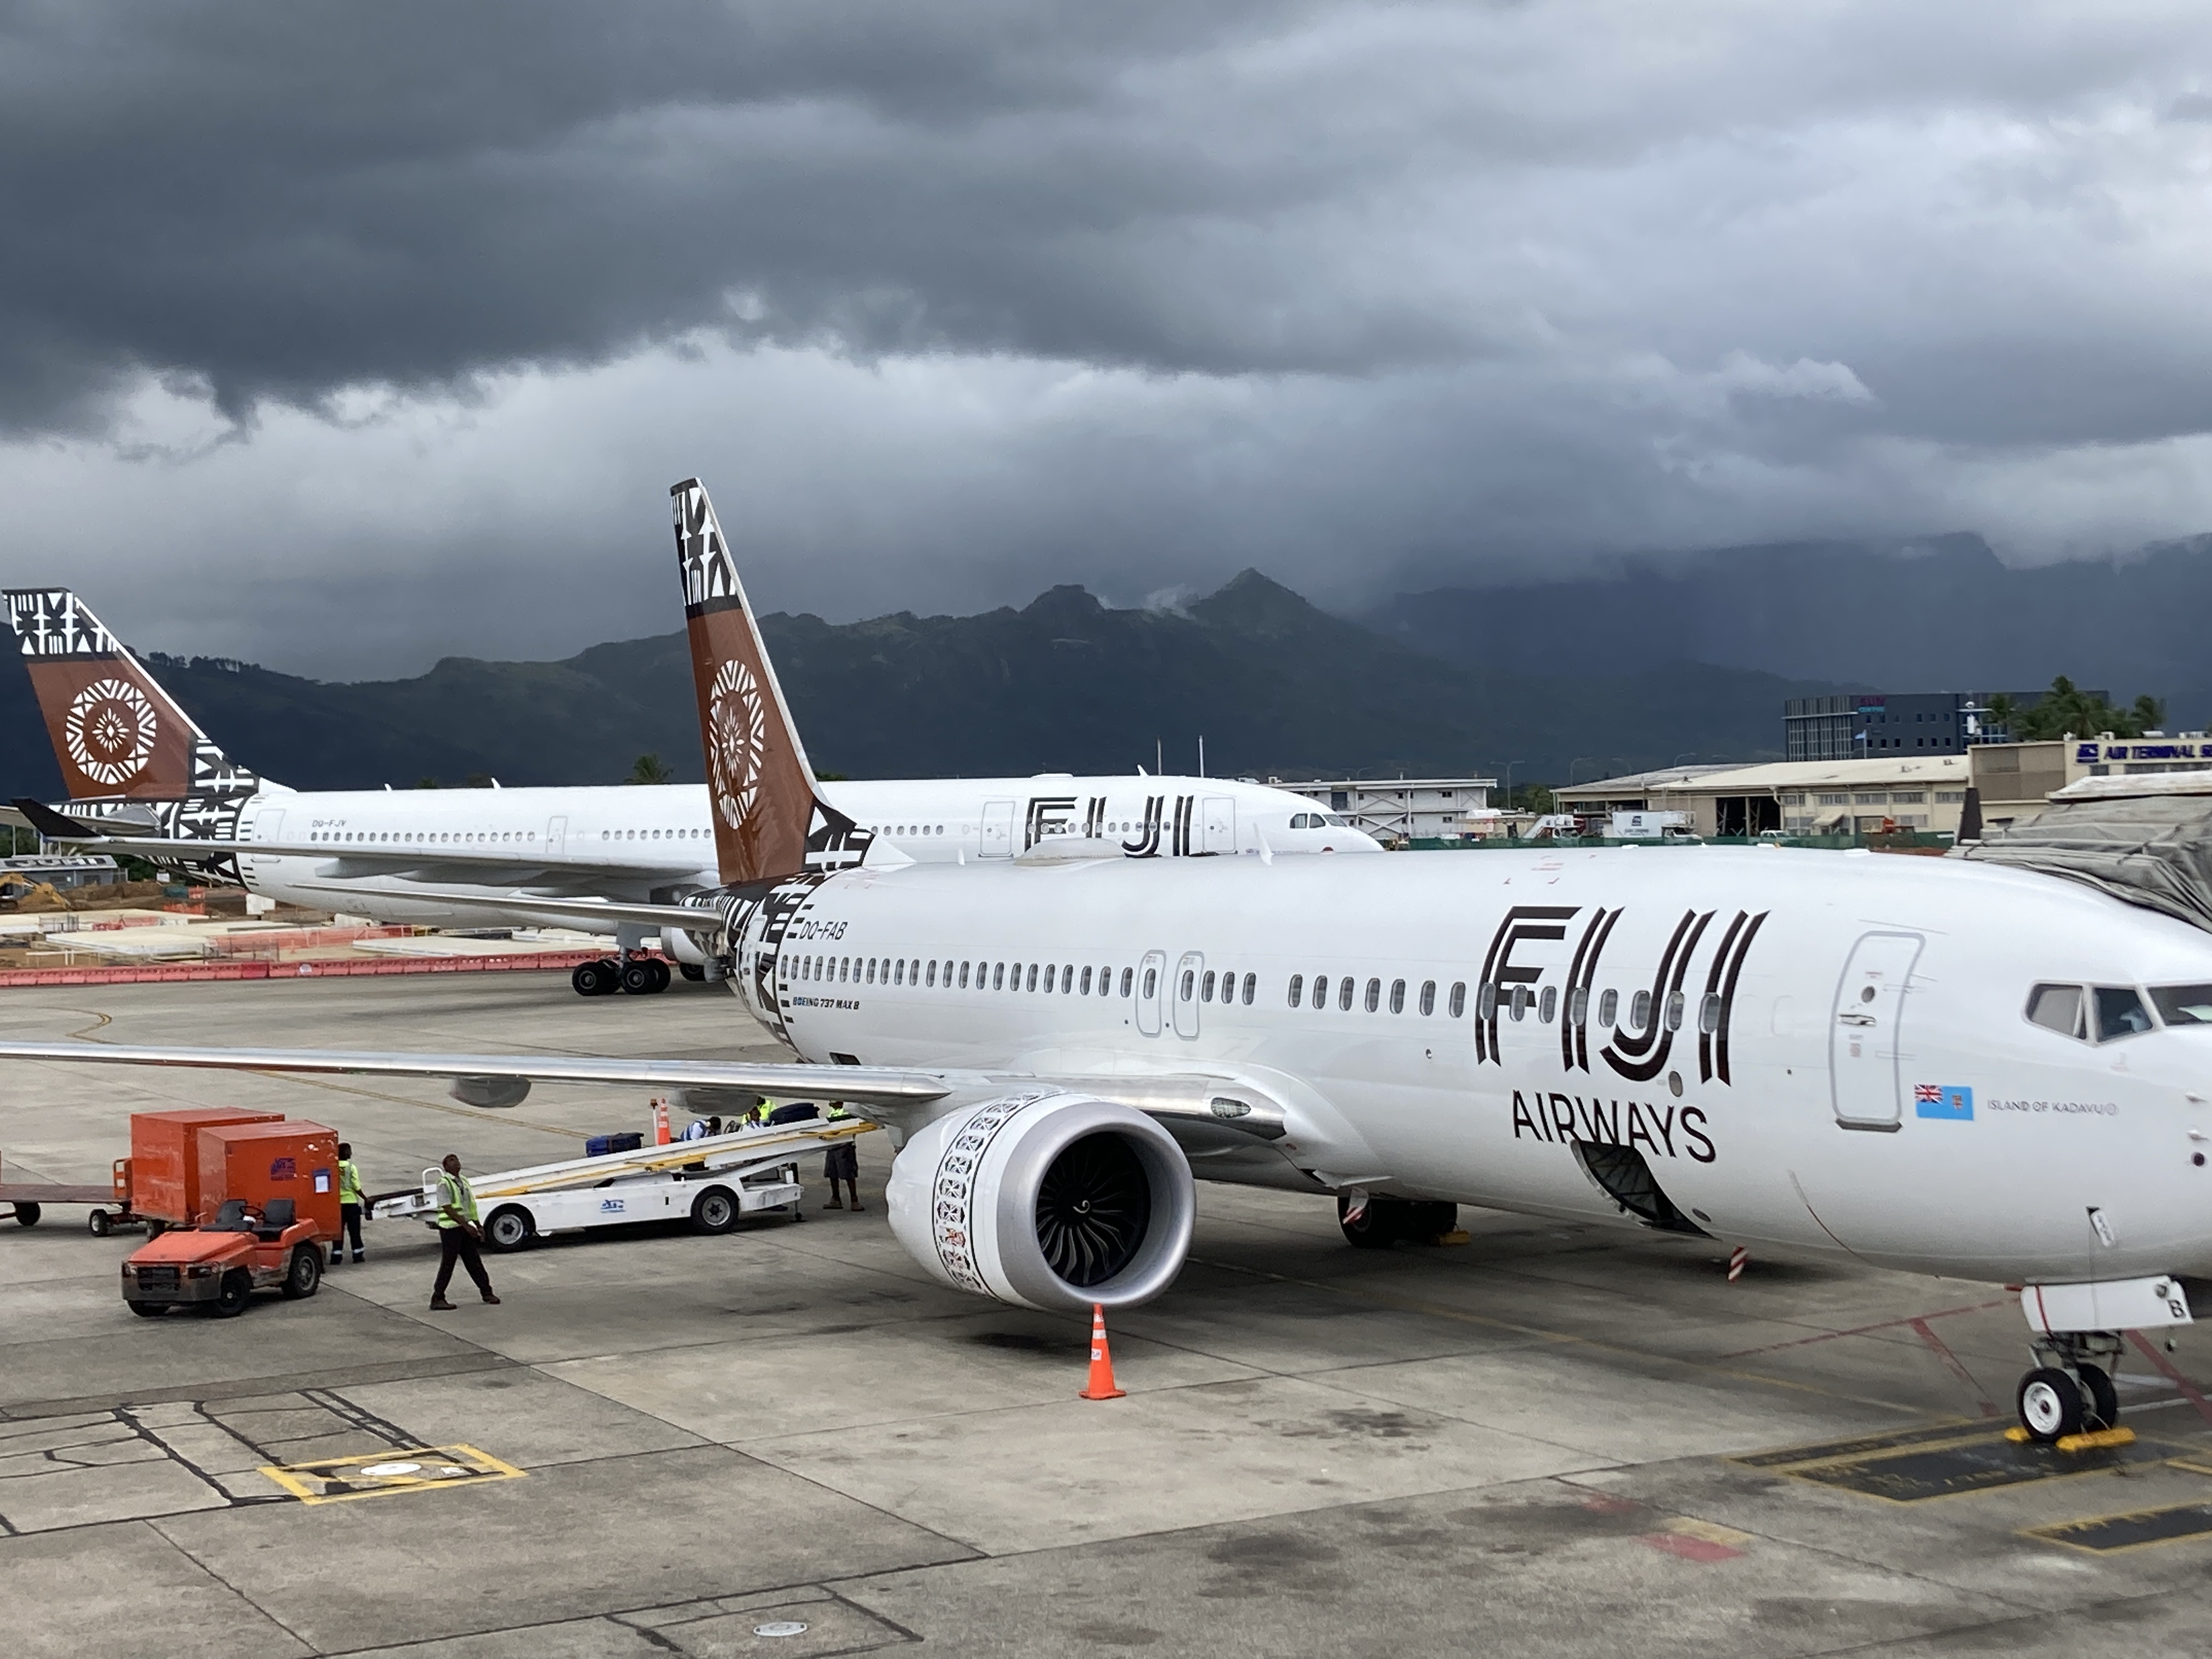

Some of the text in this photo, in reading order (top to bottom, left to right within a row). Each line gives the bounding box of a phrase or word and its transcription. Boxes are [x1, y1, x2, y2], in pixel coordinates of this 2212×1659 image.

[2103, 746, 2128, 759] AIR
[2132, 745, 2195, 758] TERMINAL
[1024, 795, 1194, 858] FIJI
[799, 921, 848, 940] DQ-FAB
[793, 997, 859, 1009] BOEING 737 MAX 8
[1475, 906, 1771, 1087] FIJI
[1987, 1099, 2104, 1115] ISLAND OF KADAVU
[1513, 1090, 1716, 1163] AIRWAYS
[2168, 1299, 2186, 1318] B
